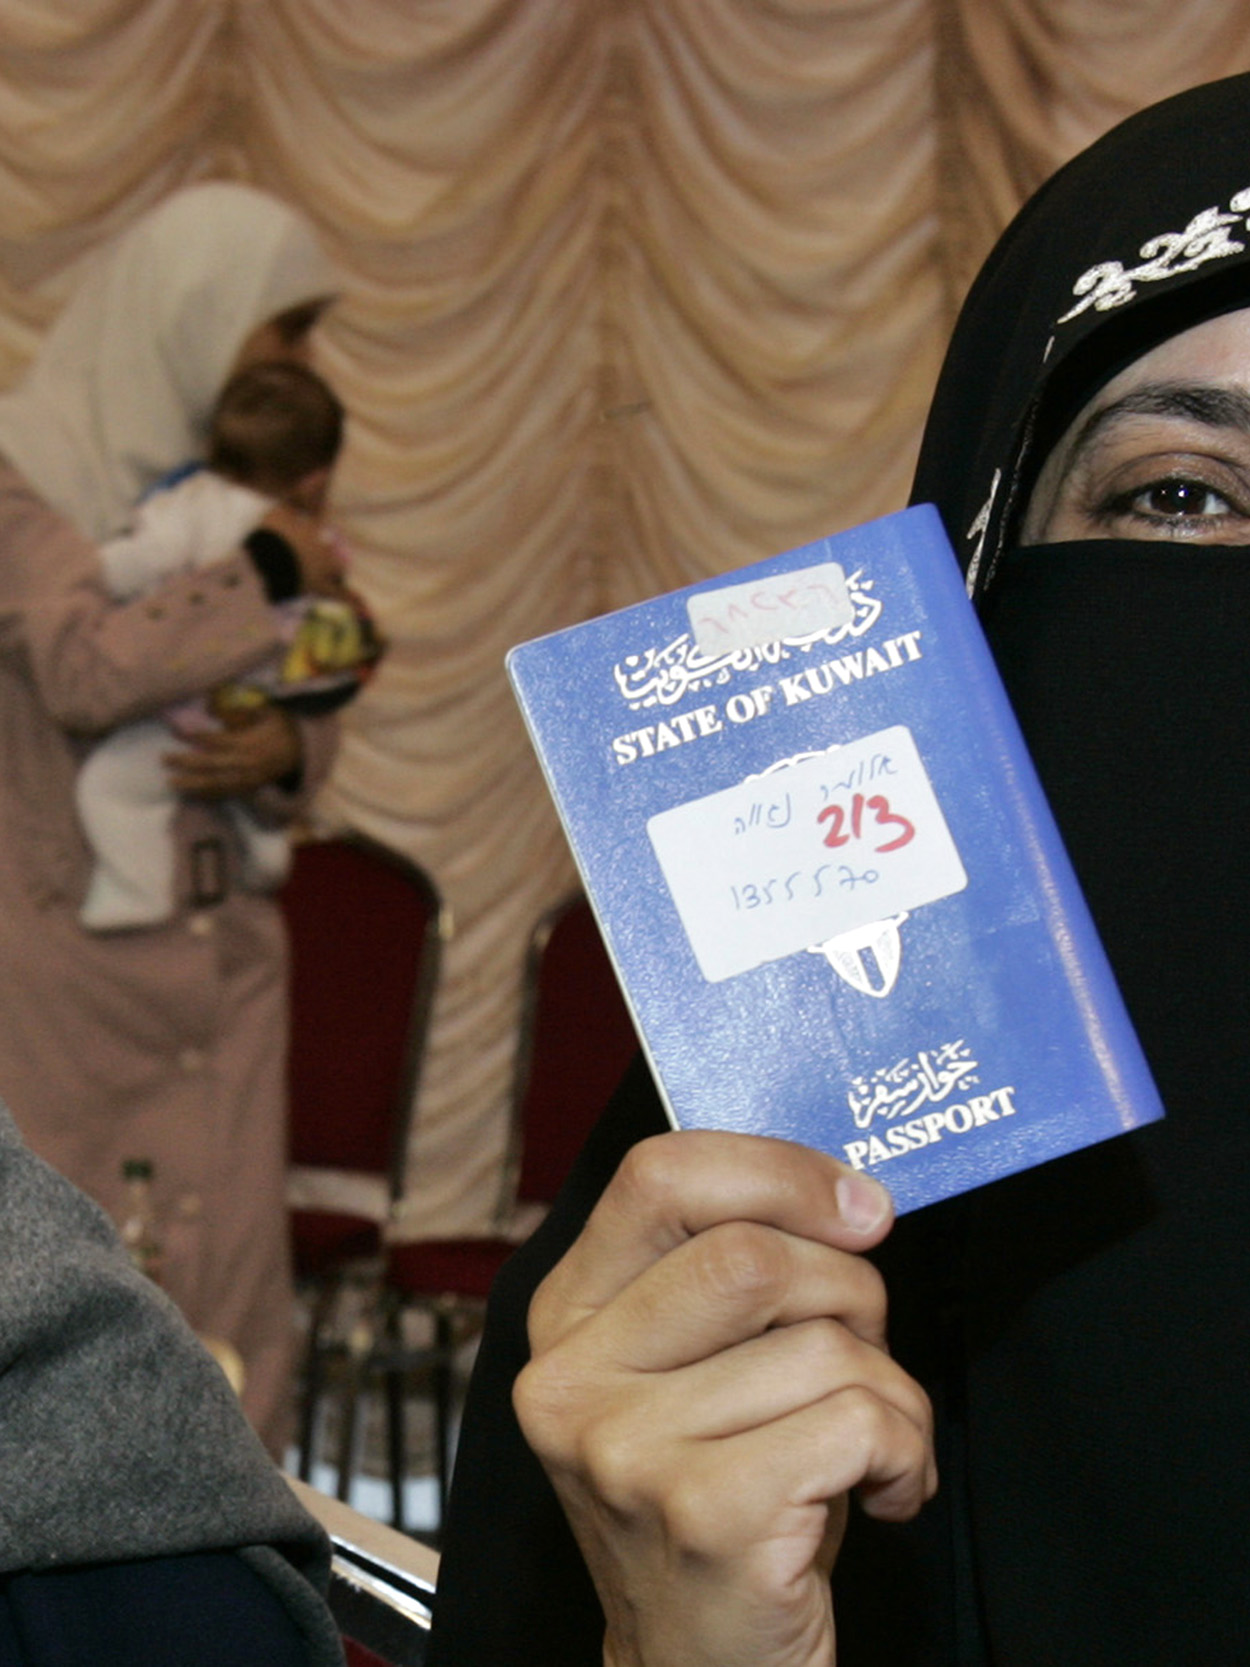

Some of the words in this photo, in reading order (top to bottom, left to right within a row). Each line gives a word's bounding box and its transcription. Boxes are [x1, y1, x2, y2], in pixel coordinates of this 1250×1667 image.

[612, 704, 723, 766] STATE
[726, 685, 774, 724] OF
[778, 630, 923, 706] KUWAIT
[847, 1059, 920, 1129] سفر
[900, 1039, 980, 1116] جواز
[842, 1085, 1017, 1171] PASSPORT
